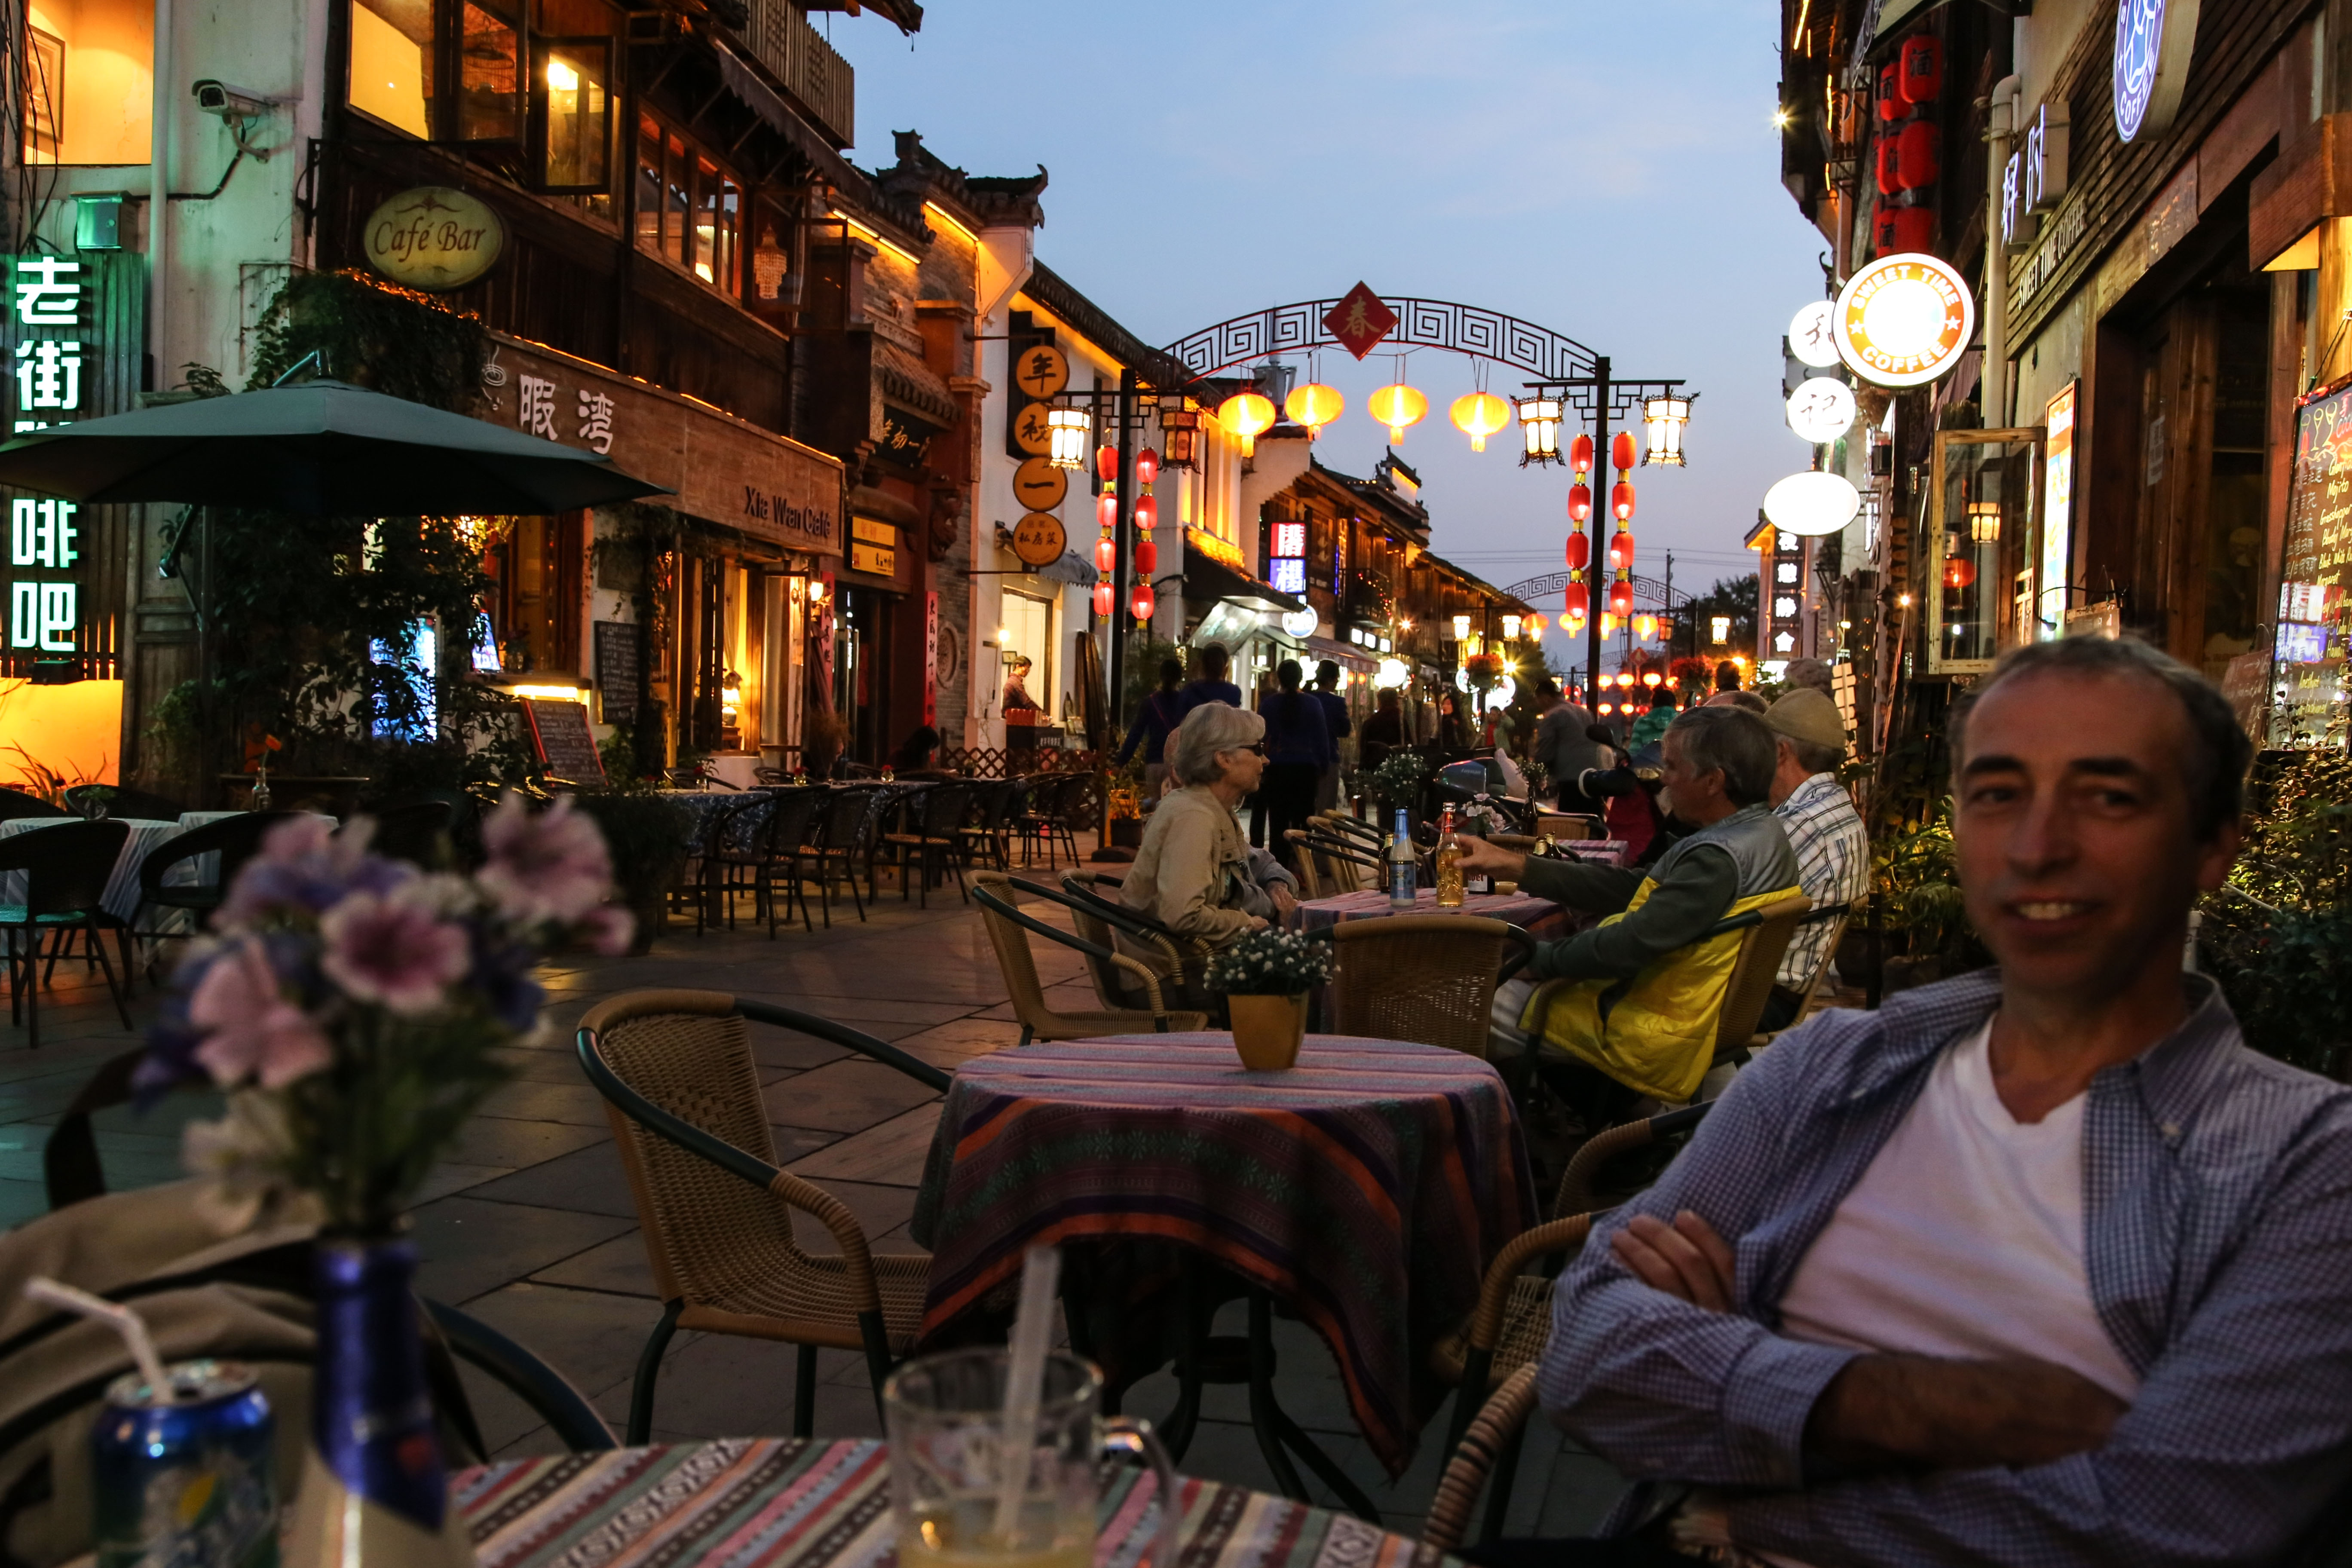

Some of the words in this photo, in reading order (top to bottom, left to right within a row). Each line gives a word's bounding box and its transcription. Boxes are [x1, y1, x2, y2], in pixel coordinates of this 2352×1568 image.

[2120, 47, 2155, 125] COFFEE
[374, 216, 435, 263] Café
[437, 220, 487, 251] Bar
[2018, 254, 2039, 311] SWEET
[2041, 231, 2057, 283] TIME
[2058, 193, 2086, 260] COFFEE
[1851, 265, 1912, 309] SWEET
[1922, 268, 1961, 307] TIME
[1340, 295, 1381, 339] 春
[1862, 341, 1948, 373] COFFEE
[11, 256, 80, 652] 老街啡吧
[744, 486, 769, 519] Xia
[773, 496, 801, 530] Wan
[803, 506, 832, 539] Café
[1018, 532, 1057, 546] 私房菜
